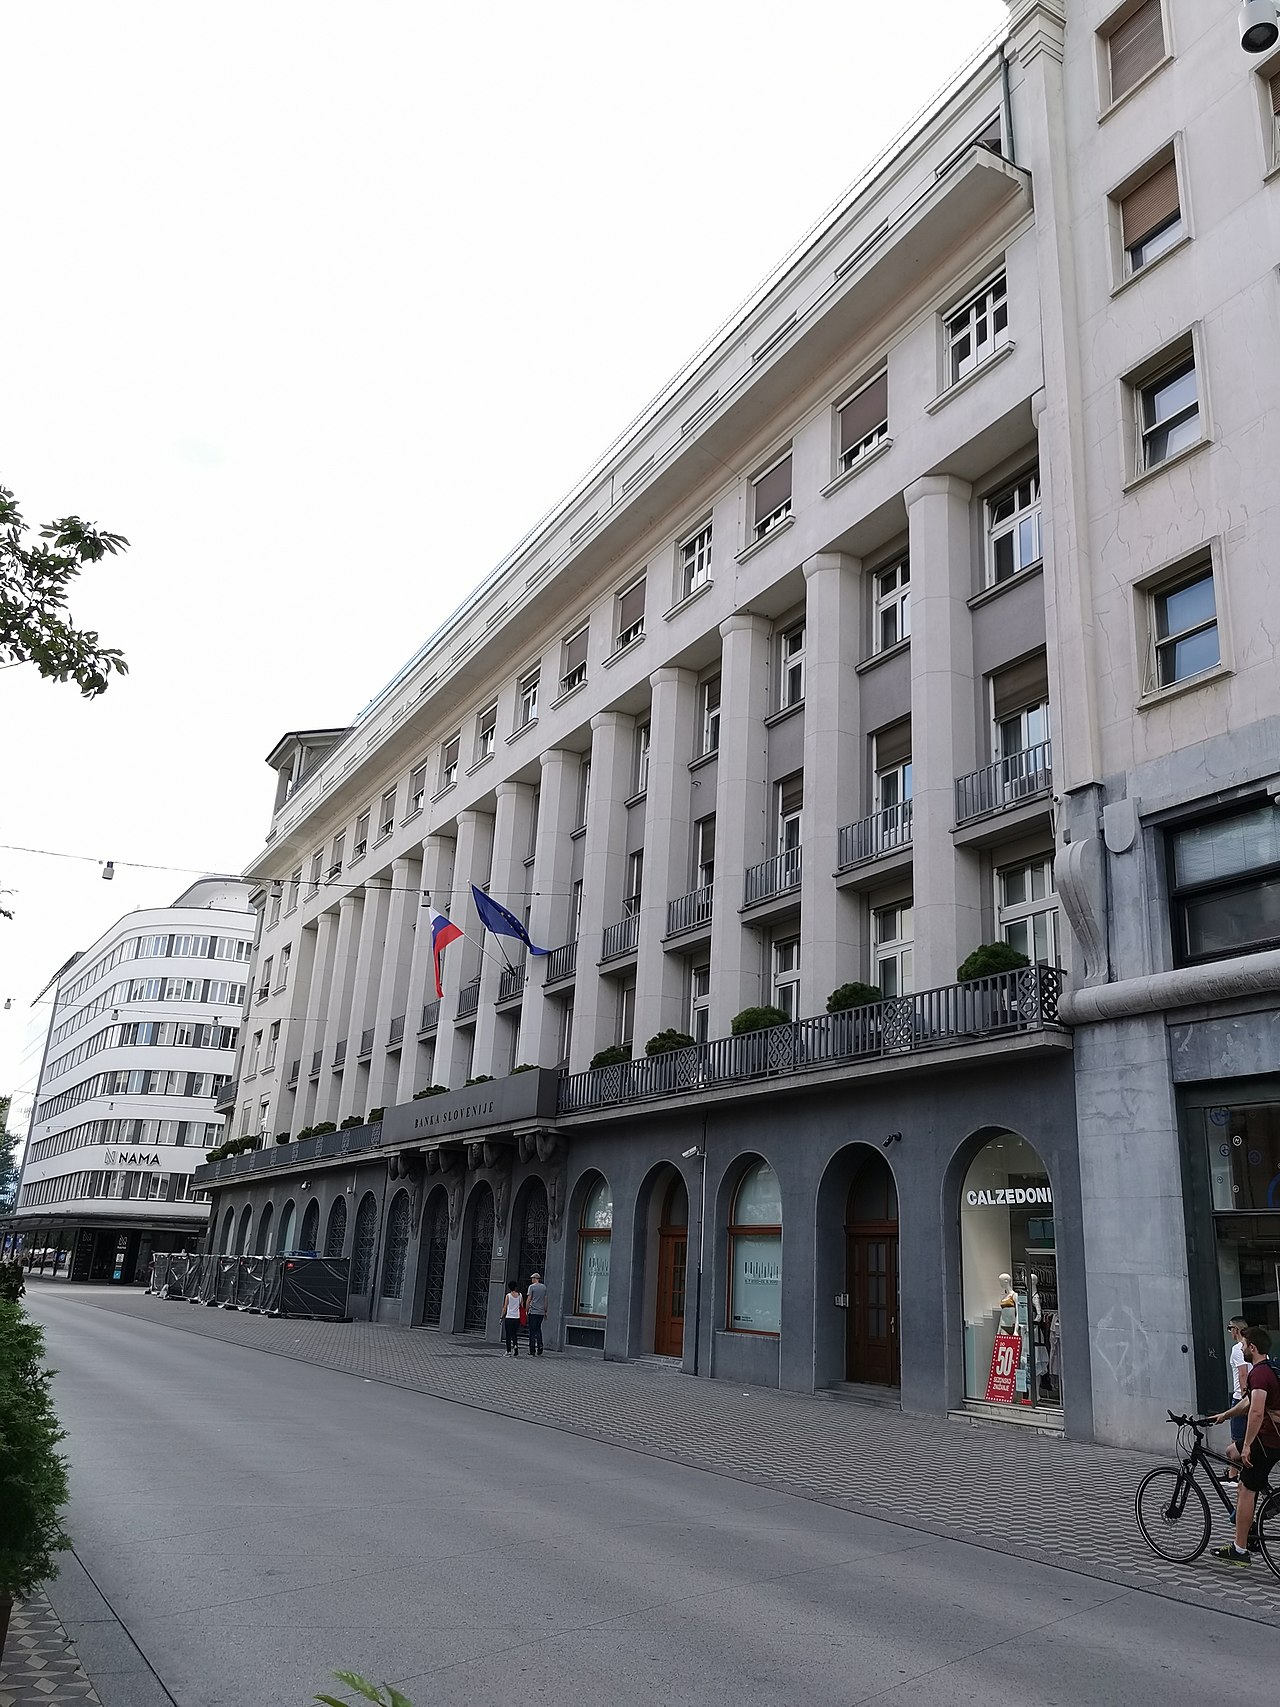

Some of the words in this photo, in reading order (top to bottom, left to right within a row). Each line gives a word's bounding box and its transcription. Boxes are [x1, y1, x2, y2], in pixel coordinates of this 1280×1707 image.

[414, 1114, 440, 1129] BANKA
[442, 1101, 494, 1123] SLOVENIJE
[118, 1151, 160, 1165] NAMA
[995, 1346, 1014, 1376] 50
